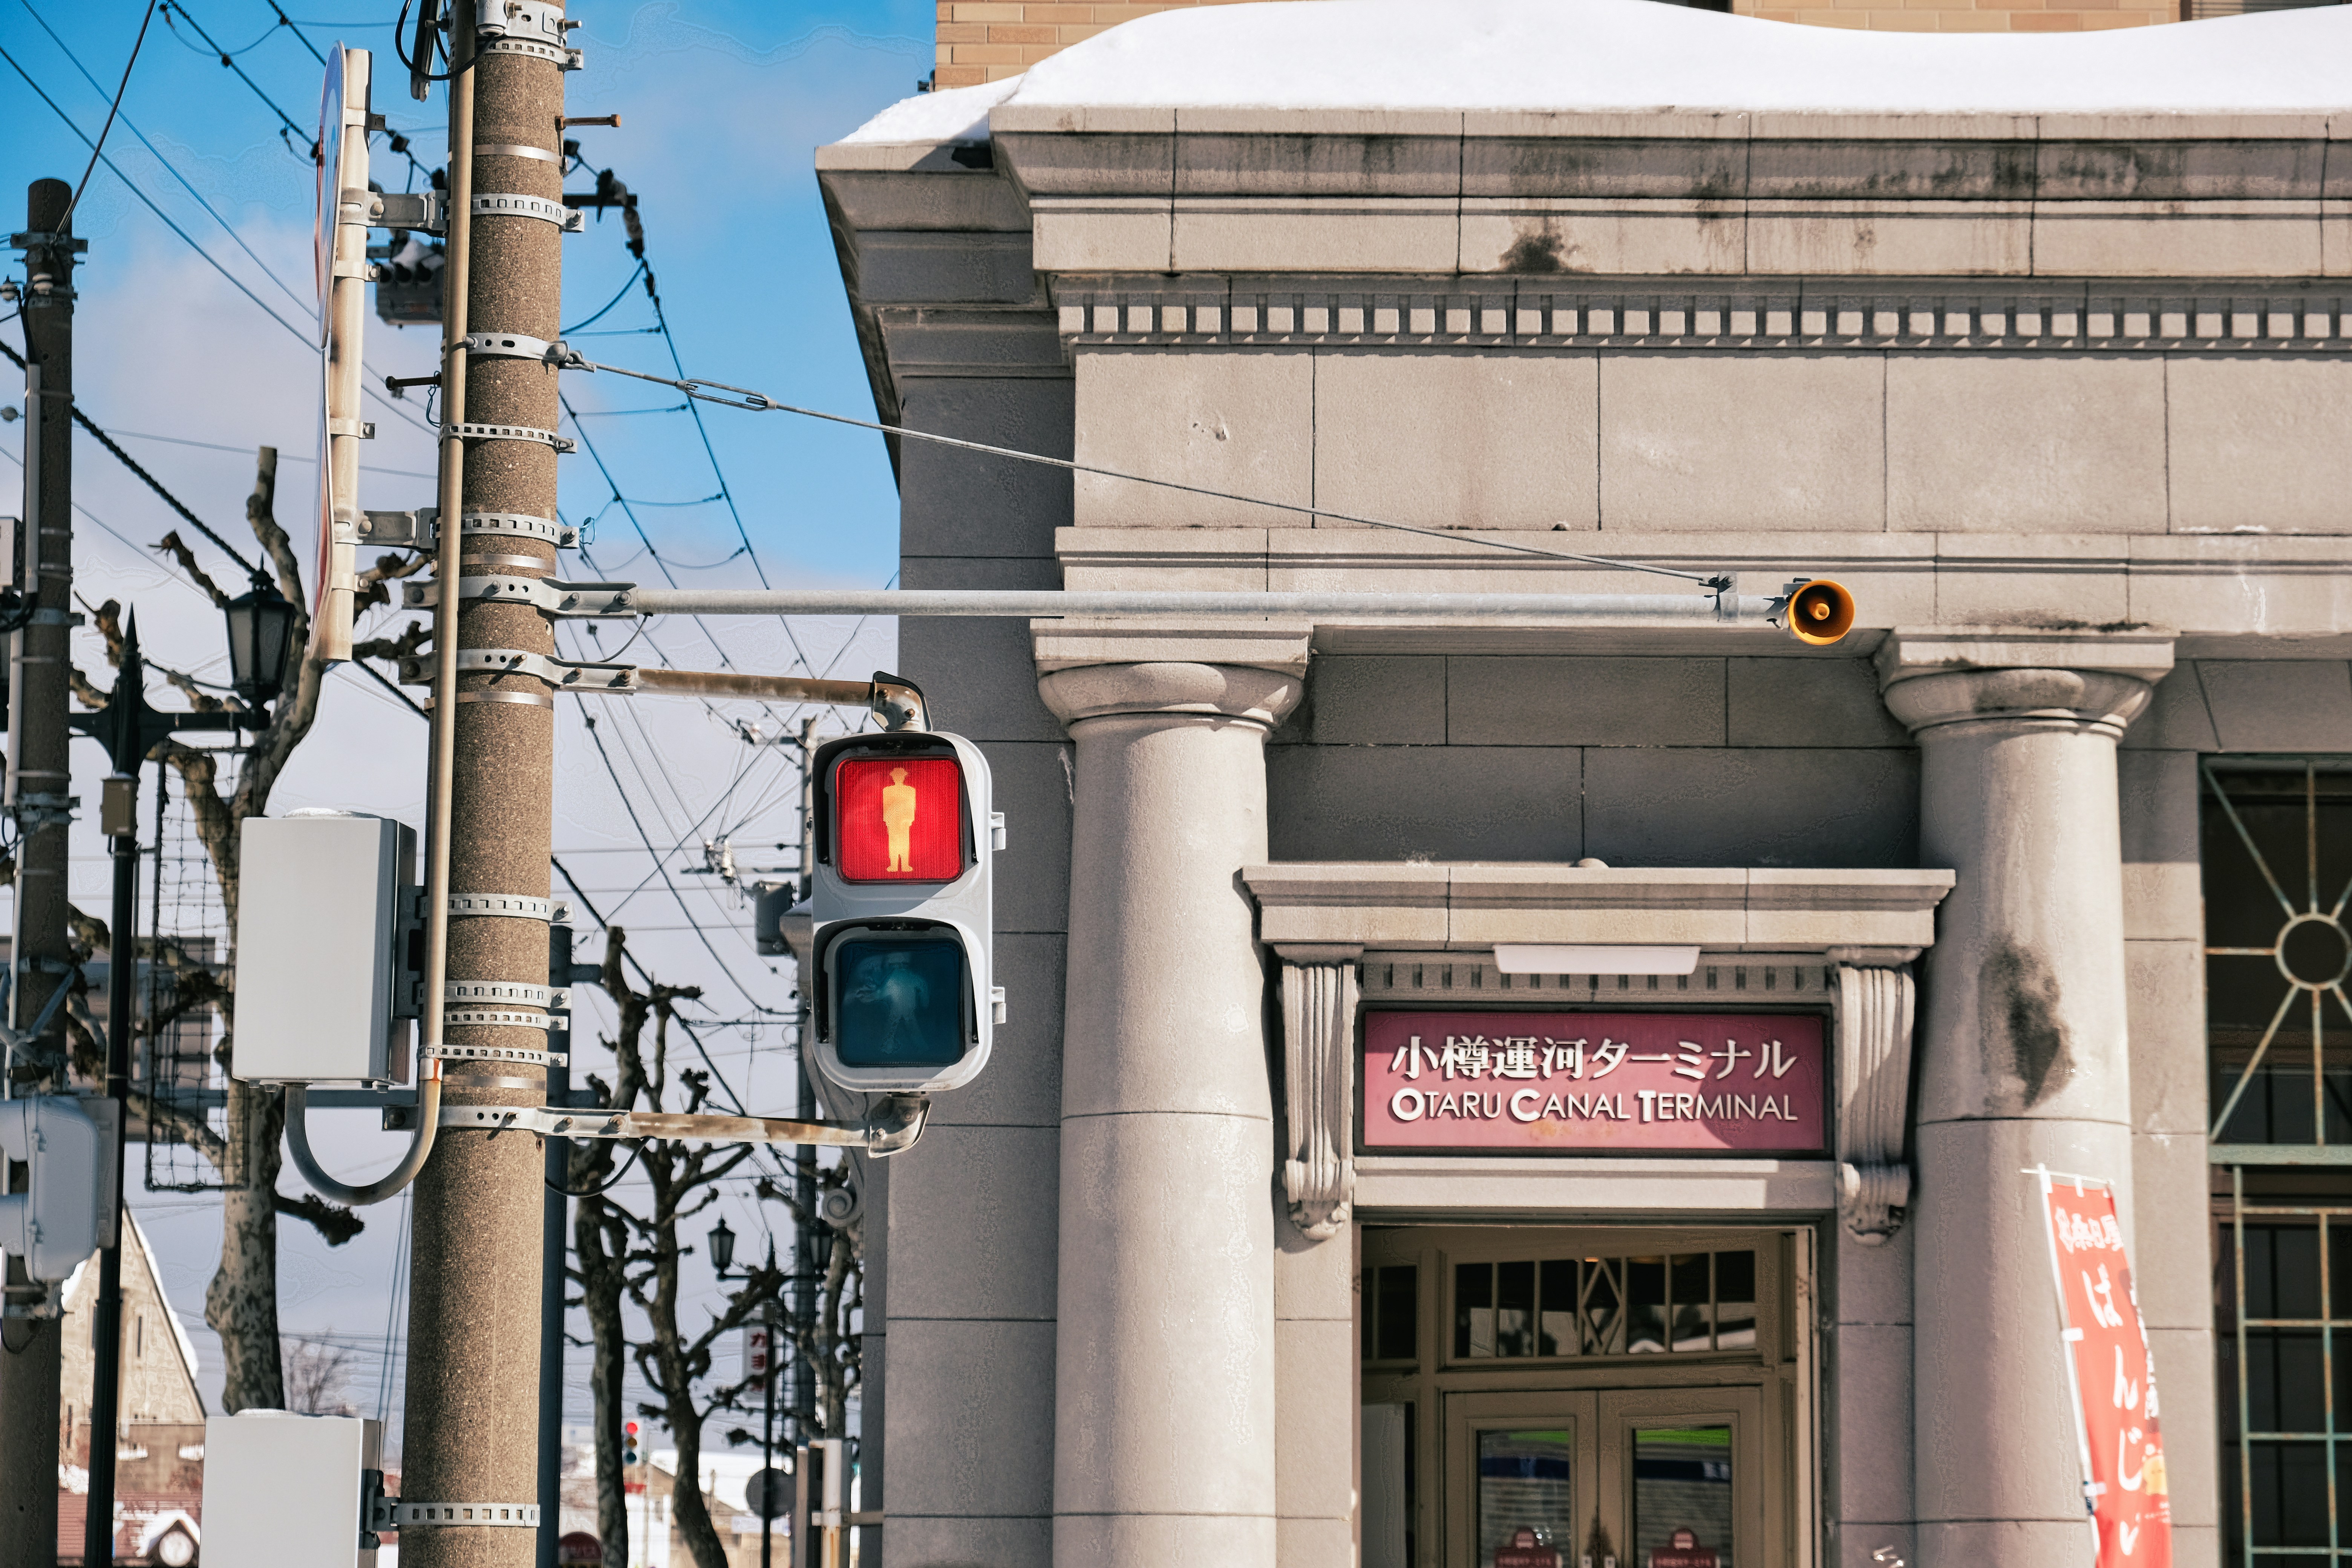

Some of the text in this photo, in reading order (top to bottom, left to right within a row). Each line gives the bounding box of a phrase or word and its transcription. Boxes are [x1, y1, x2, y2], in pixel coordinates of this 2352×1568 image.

[1392, 1035, 1797, 1080] 小樽運河ターミナル
[1391, 1087, 1798, 1122] OTARU CANAL TERMINAL
